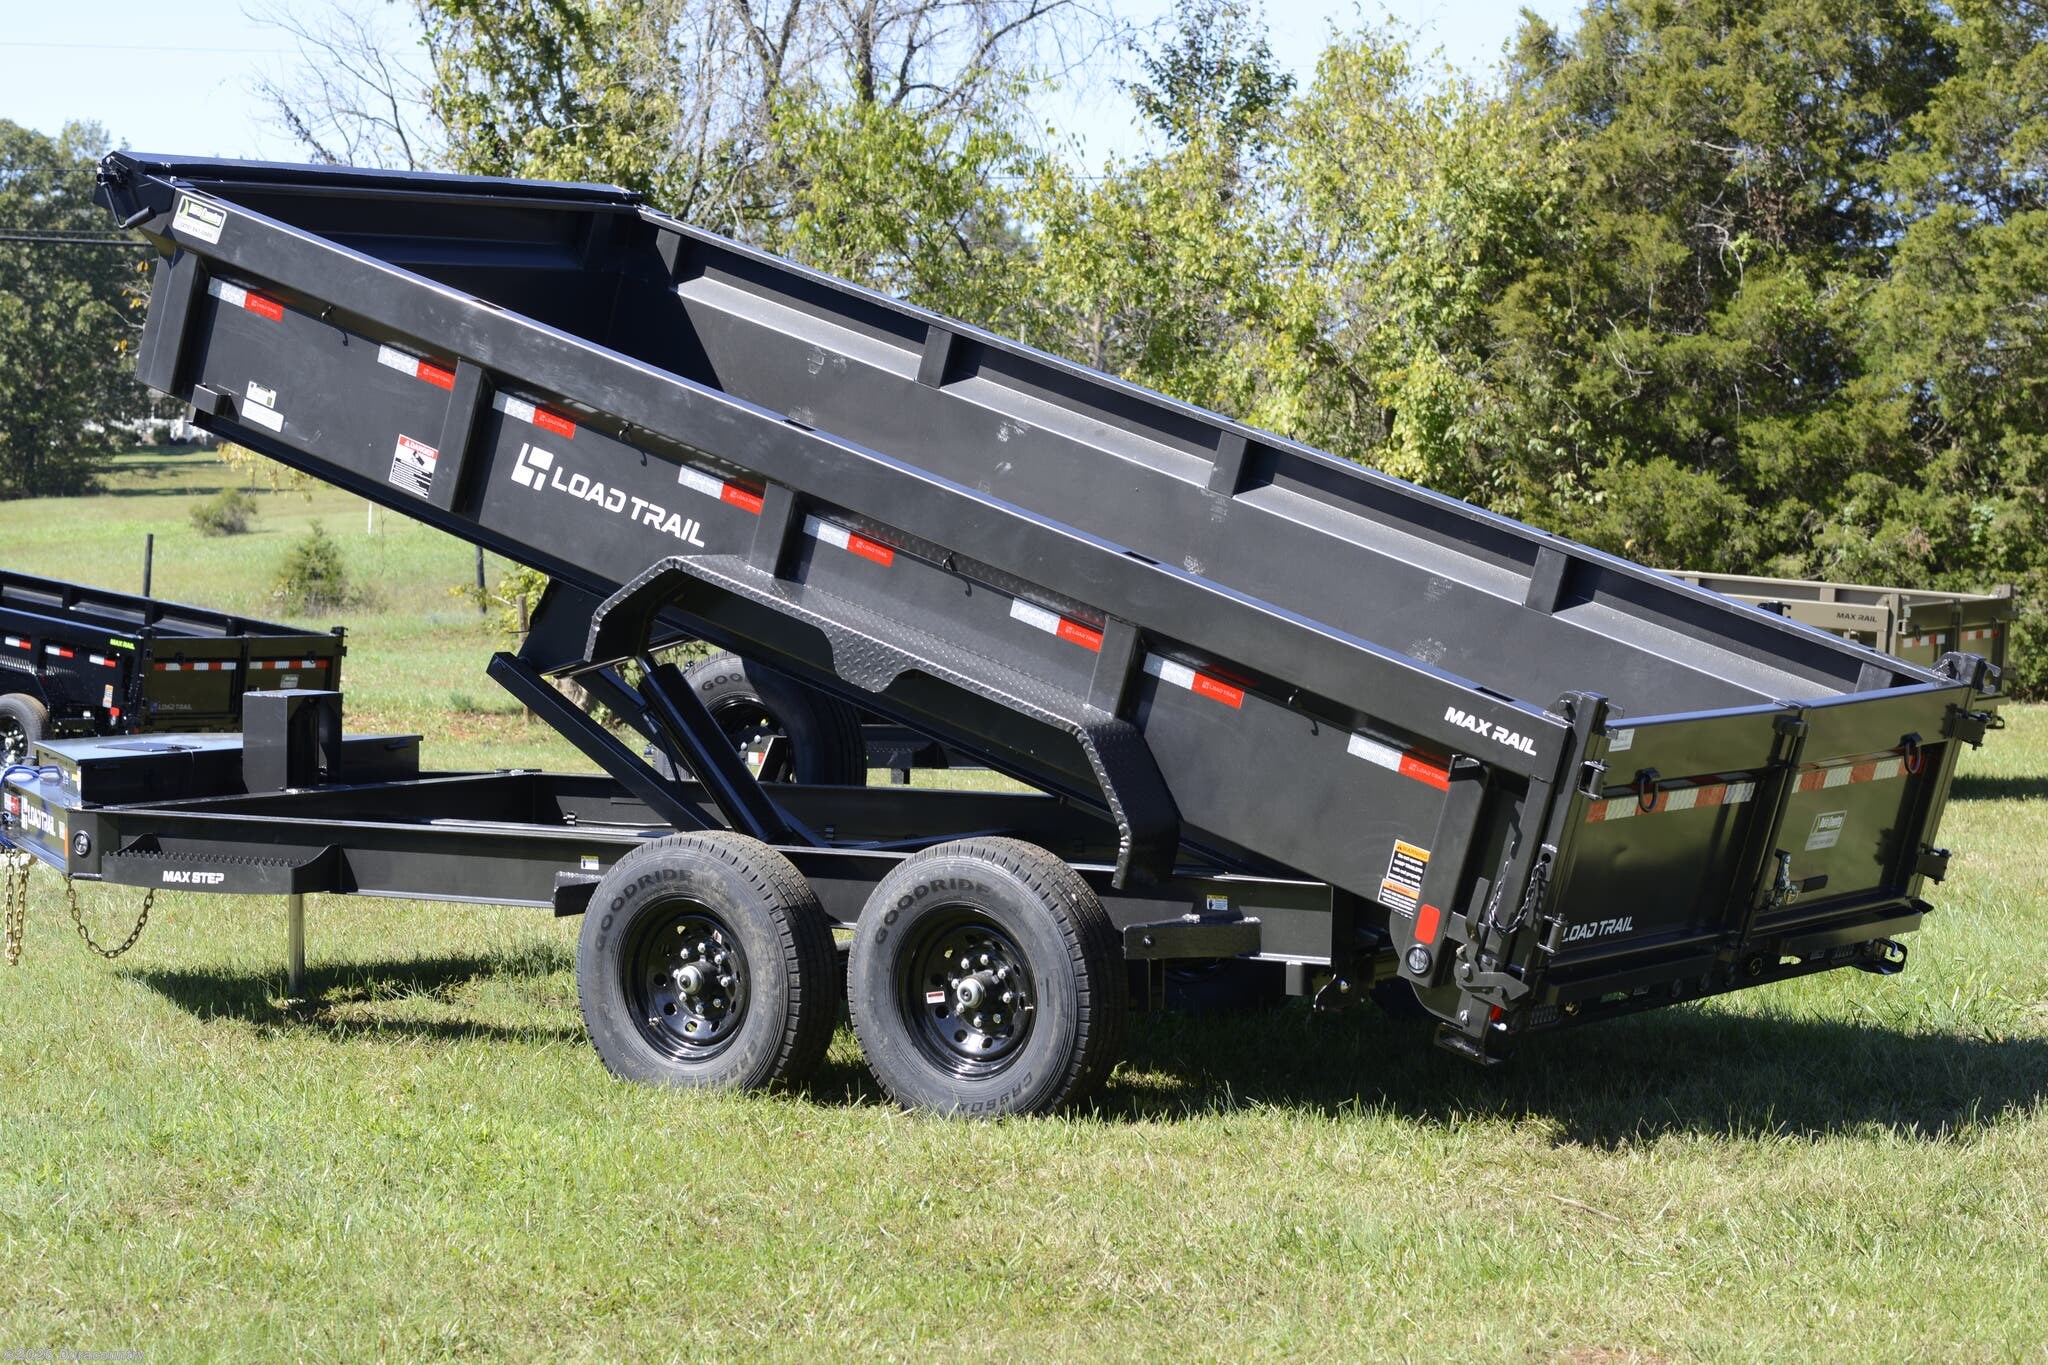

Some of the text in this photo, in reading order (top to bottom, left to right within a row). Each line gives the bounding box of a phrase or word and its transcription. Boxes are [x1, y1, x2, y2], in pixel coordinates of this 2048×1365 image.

[551, 466, 705, 548] LOAD TRAIL
[1836, 612, 1877, 623] MAX RAIL
[1444, 706, 1537, 757] MAX RAIL
[162, 871, 225, 884] MAX STEP
[595, 868, 694, 952] GOODRIDE
[874, 878, 990, 945] GOODRIDE
[1561, 916, 1633, 942] LOAD TRAIL
